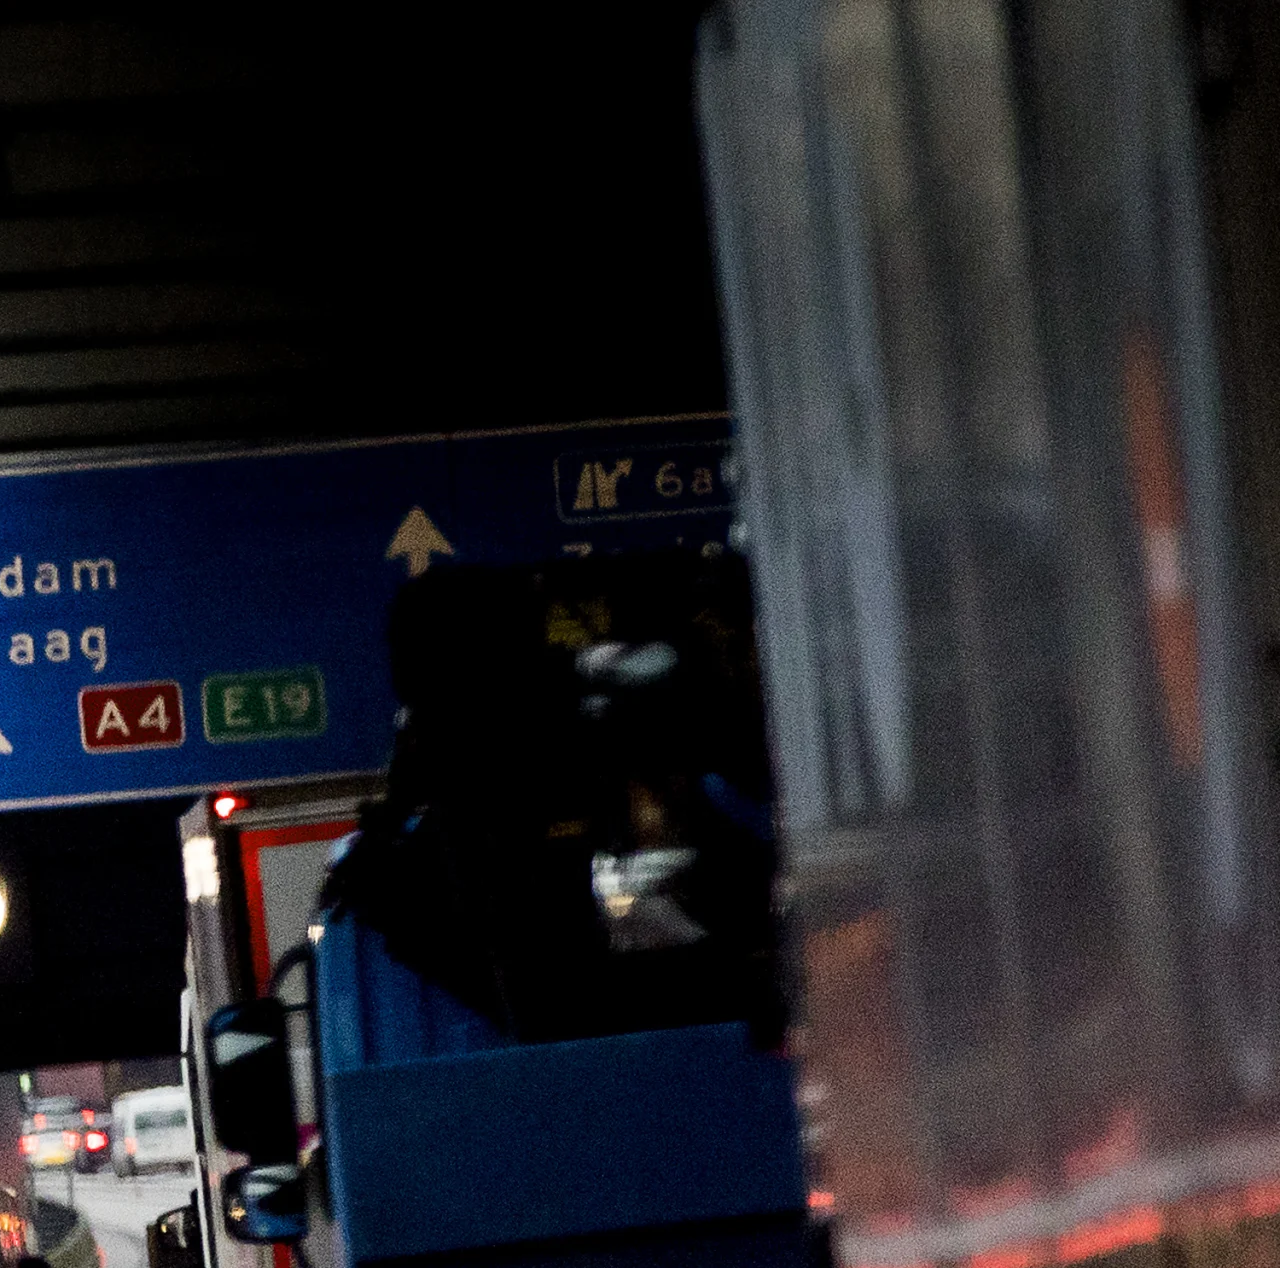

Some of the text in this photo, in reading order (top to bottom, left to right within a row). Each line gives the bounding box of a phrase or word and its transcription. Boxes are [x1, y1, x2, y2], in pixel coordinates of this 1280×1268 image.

[653, 459, 715, 499] 6a
[95, 682, 312, 741] A4 E19
